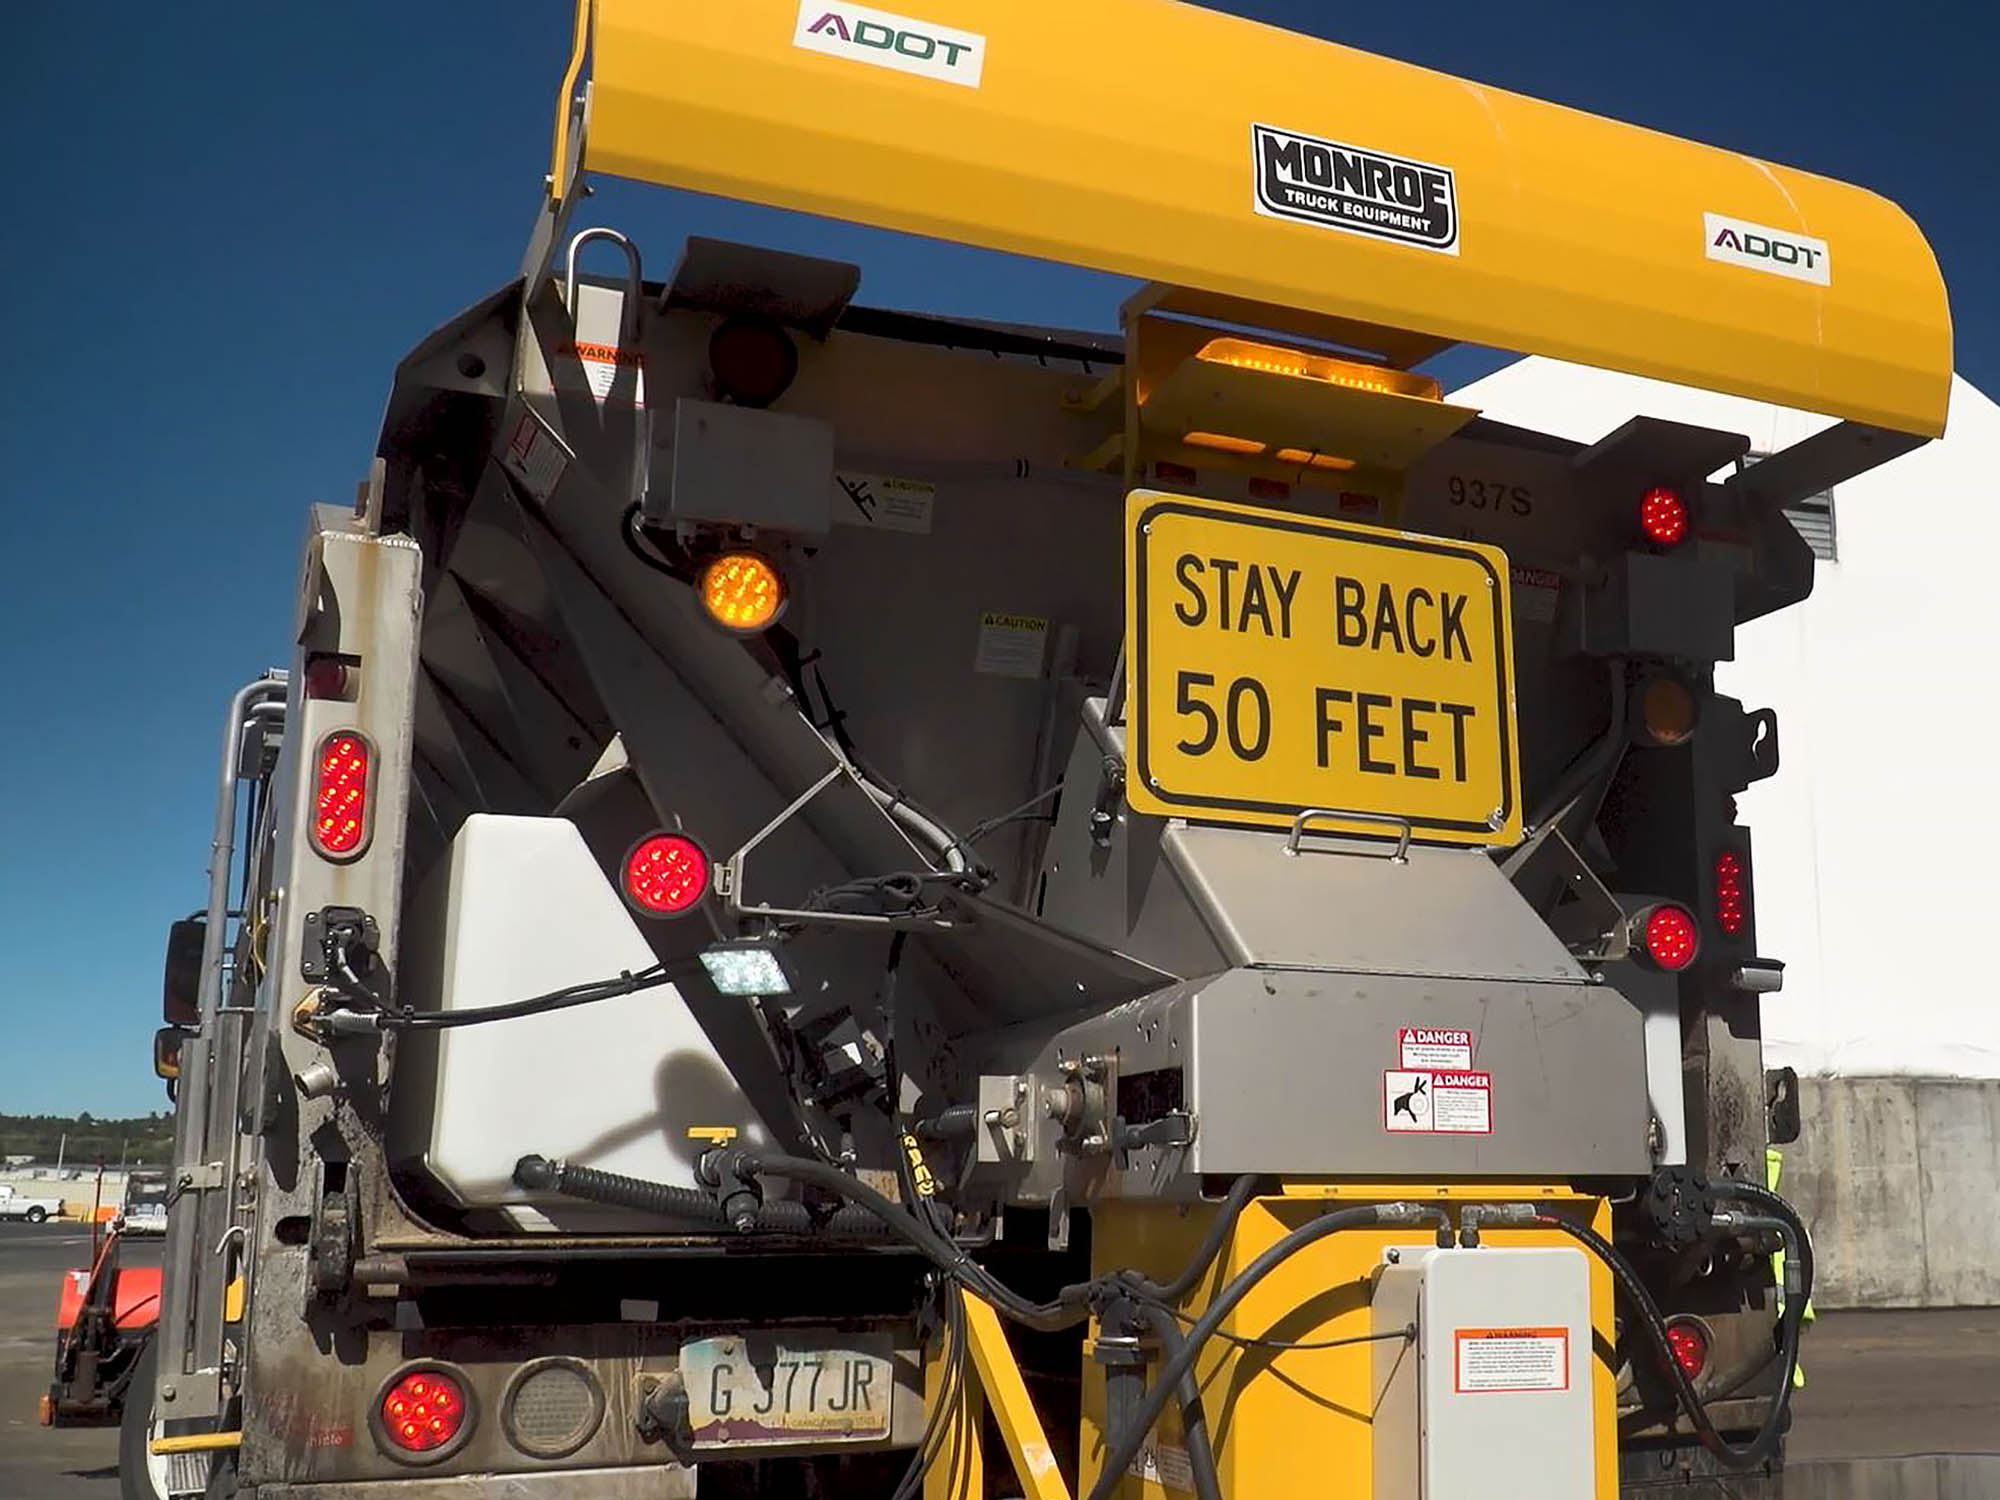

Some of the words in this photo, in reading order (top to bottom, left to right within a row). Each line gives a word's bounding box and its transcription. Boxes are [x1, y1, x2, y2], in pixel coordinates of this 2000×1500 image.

[807, 13, 972, 66] ADOT
[1262, 134, 1447, 211] MONROE
[1285, 189, 1339, 212] TRUCK
[1343, 203, 1431, 232] EQUIPMENT
[1714, 228, 1821, 269] ADOT
[1449, 475, 1532, 517] 937S
[1175, 553, 1302, 639] STAY
[1335, 576, 1473, 663] BACK
[1175, 670, 1271, 762] 50
[1315, 686, 1476, 782] FEET
[1417, 1031, 1469, 1045] DANGER
[1445, 1075, 1489, 1087] DANGER
[710, 1364, 733, 1416] G
